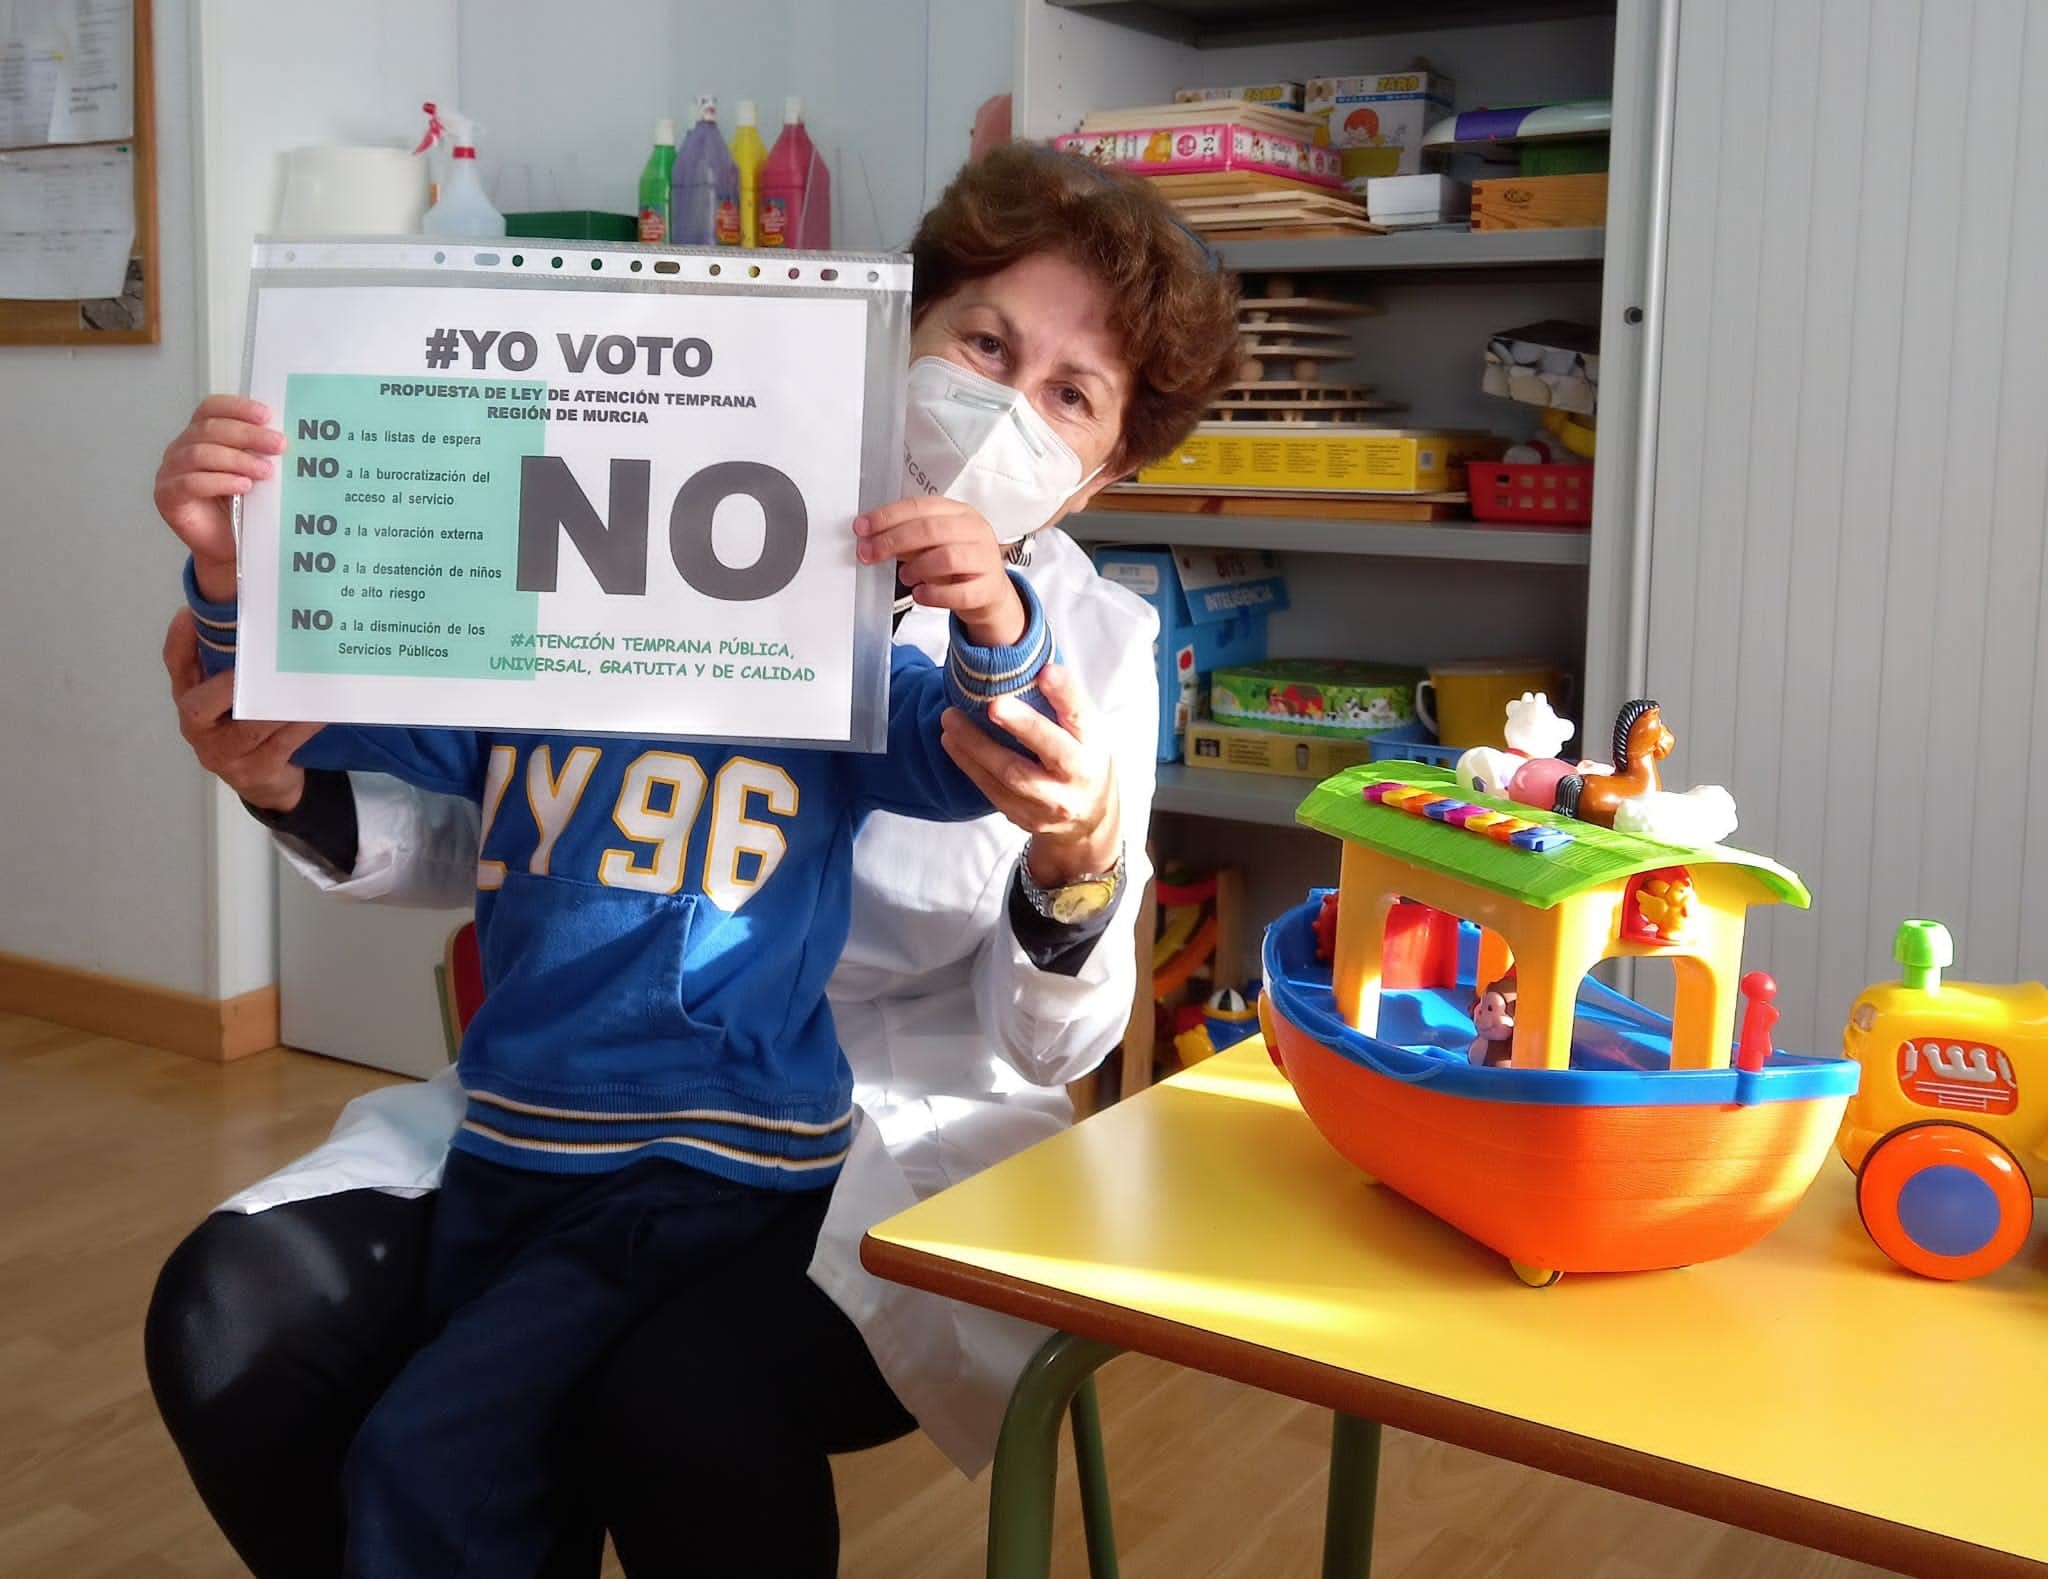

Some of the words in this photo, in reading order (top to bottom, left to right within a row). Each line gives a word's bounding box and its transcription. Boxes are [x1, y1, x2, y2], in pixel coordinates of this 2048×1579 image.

[425, 328, 538, 372] #YO
[556, 333, 713, 378] VOTO
[380, 383, 480, 399] PROPUESTA
[484, 387, 506, 400] DE
[511, 388, 543, 401] LEY
[548, 389, 570, 402] DE
[574, 387, 660, 406] ATENCIÓN
[664, 393, 757, 408] TEMPRANA
[487, 404, 551, 421] REGIÓN
[556, 407, 579, 422] DE
[583, 408, 649, 424] MURCIA
[298, 419, 341, 441] NO
[348, 433, 355, 441] a
[361, 430, 378, 442] las
[385, 431, 416, 443] listas
[422, 432, 437, 444] de
[442, 435, 482, 446] espera
[297, 456, 340, 479] NO
[346, 470, 353, 479] a
[360, 467, 370, 479] la
[376, 467, 466, 483] burocratización
[472, 471, 490, 483] del
[344, 493, 386, 503] acceso
[392, 492, 402, 504] al
[408, 493, 455, 506] servicio
[295, 514, 338, 536] NO
[344, 527, 351, 536] a
[358, 525, 368, 537] la
[374, 525, 434, 539] valoración
[440, 529, 484, 541] externa
[516, 456, 809, 601] NO
[293, 551, 336, 573] NO
[342, 564, 350, 574] a
[356, 562, 367, 574] la
[372, 563, 443, 577] desatención
[449, 565, 464, 577] de
[470, 564, 502, 578] niños
[340, 585, 355, 597] de
[361, 586, 383, 598] alto
[389, 587, 426, 602] riesgo
[291, 609, 333, 630] NO
[340, 622, 347, 631] a
[353, 620, 364, 632] la
[370, 621, 441, 634] disminución
[447, 622, 462, 634] de
[468, 623, 486, 635] los
[338, 643, 392, 656] Servicios
[399, 643, 449, 658] Públicos
[510, 632, 615, 650] #ATENCIÓN
[622, 637, 712, 654] TEMPRANA
[719, 637, 795, 660] PÚBLICA,
[489, 656, 592, 675] UNIVERSAL,
[600, 659, 687, 677] GRATUITA
[695, 664, 705, 677] Y
[712, 665, 734, 679] DE
[740, 666, 816, 682] CALIDAD
[597, 750, 799, 912] 96
